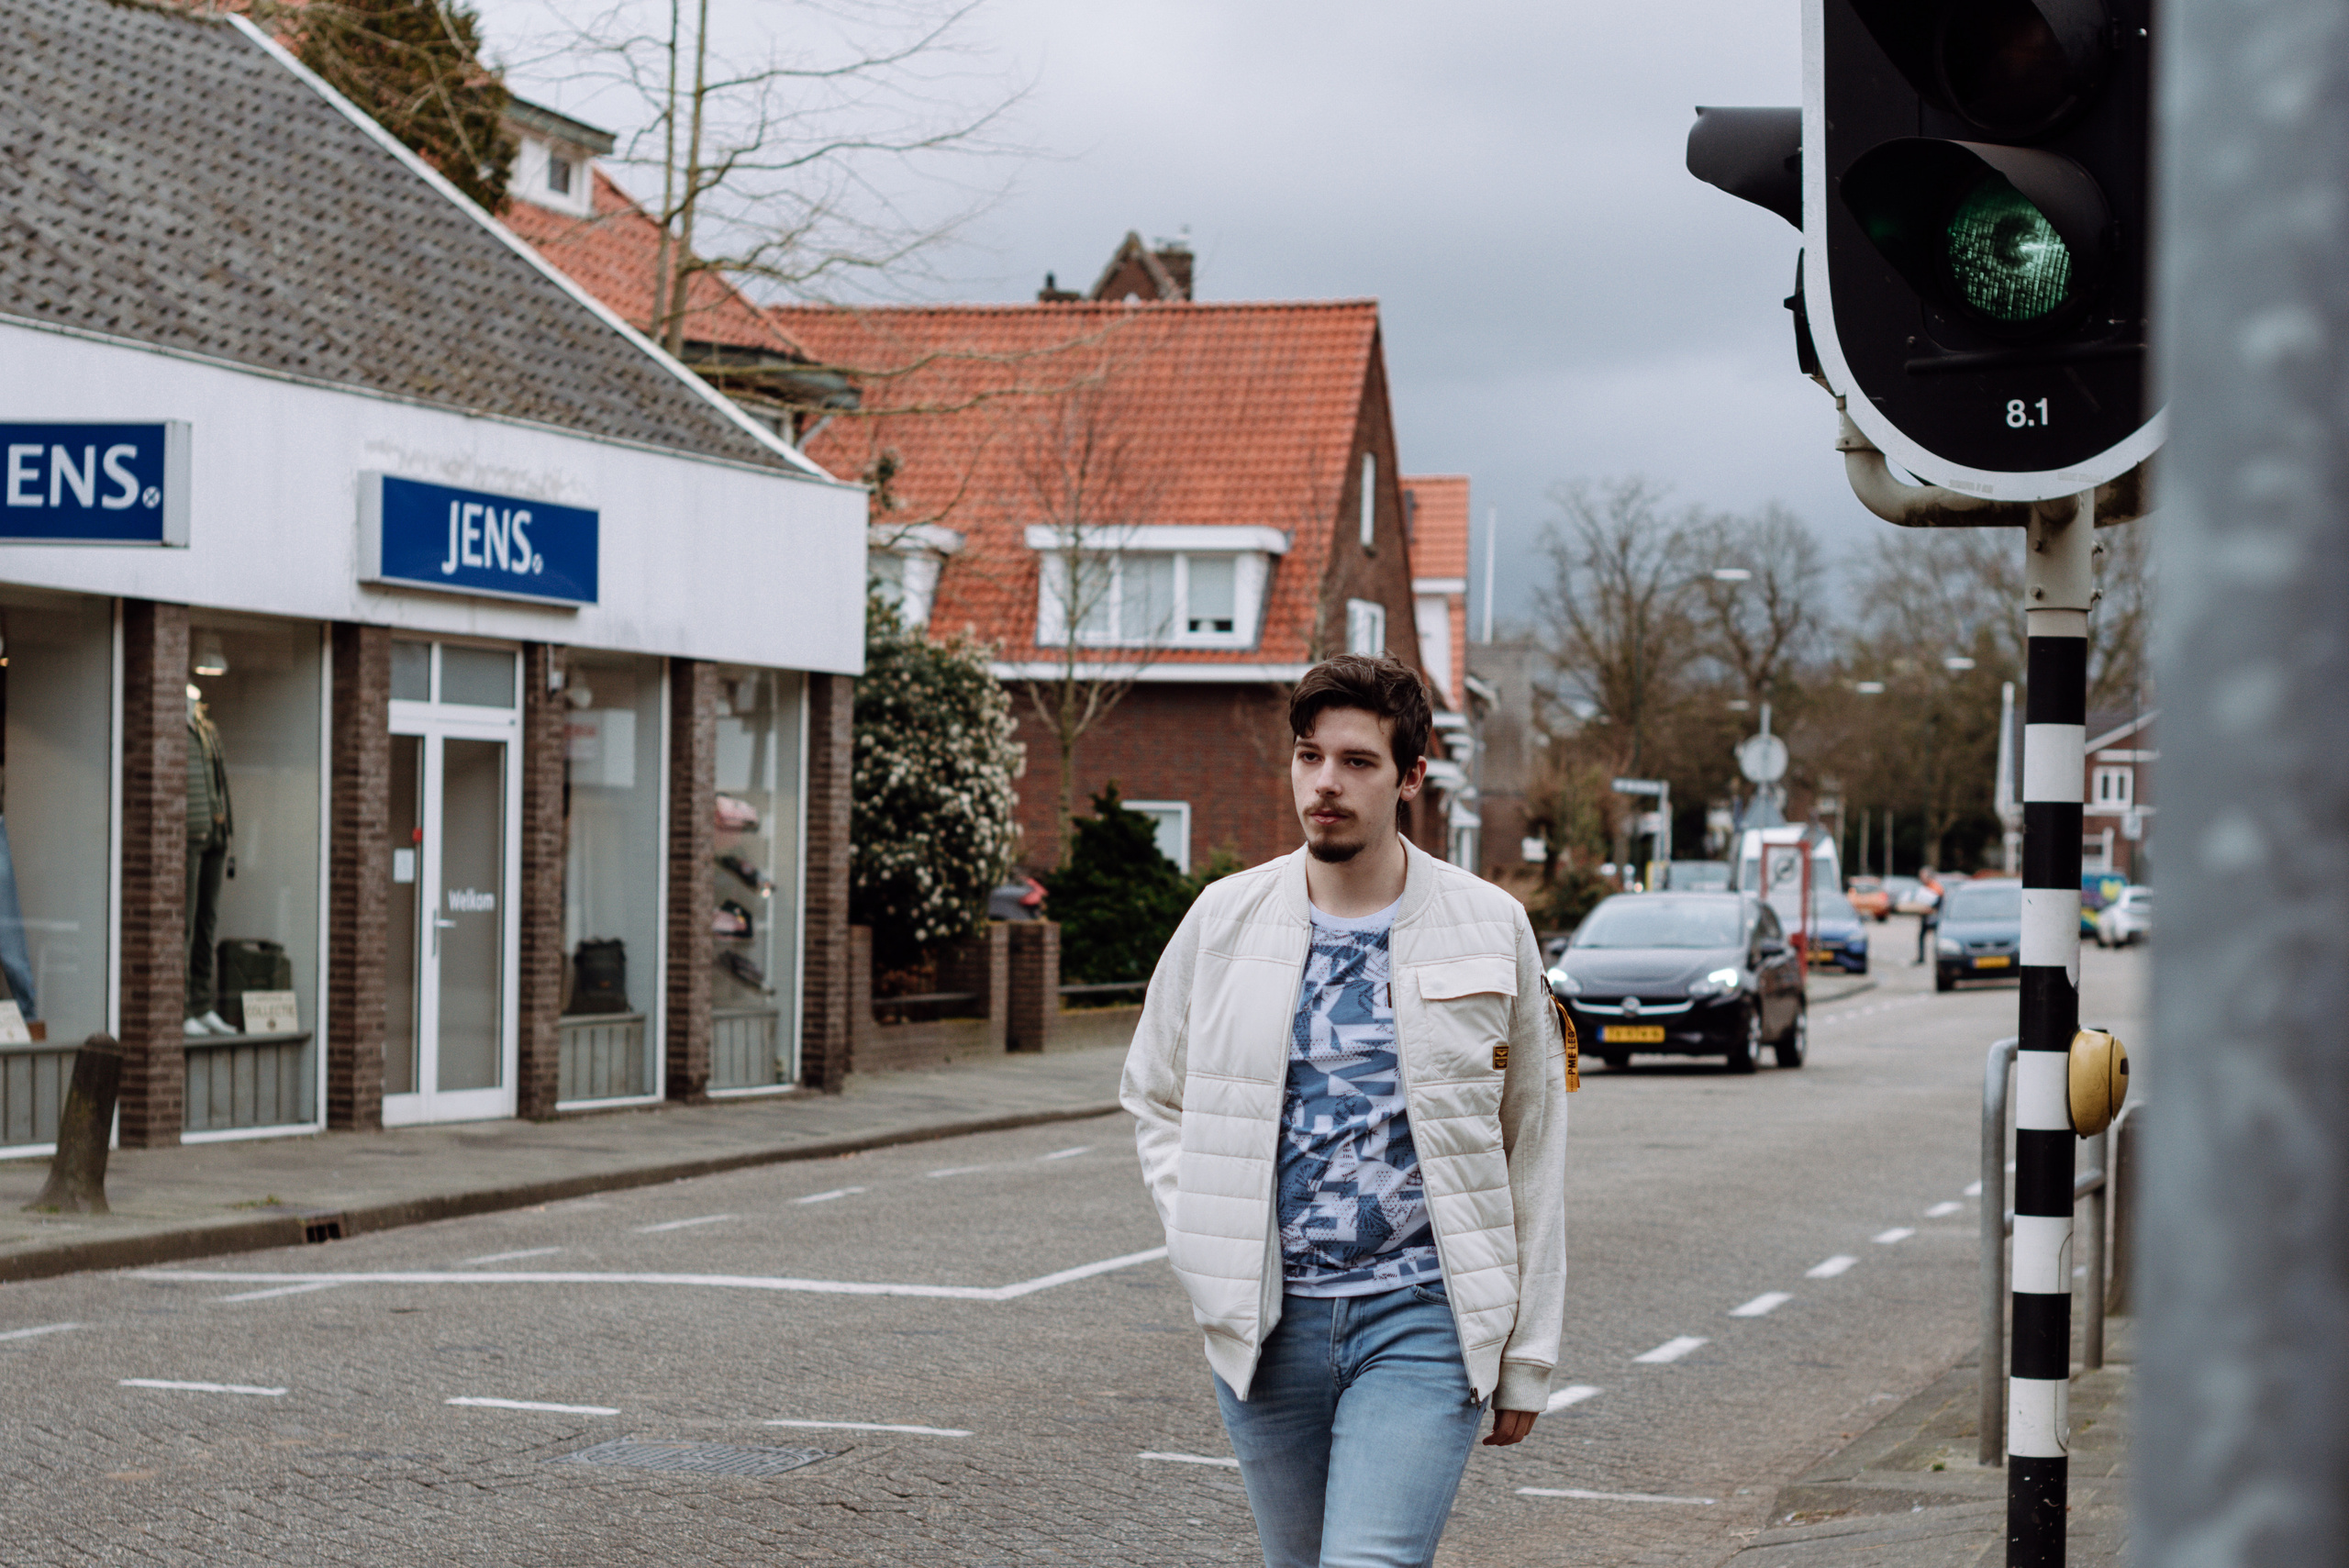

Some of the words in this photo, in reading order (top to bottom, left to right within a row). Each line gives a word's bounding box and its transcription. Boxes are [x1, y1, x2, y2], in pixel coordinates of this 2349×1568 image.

[2007, 397, 2048, 428] 8.1
[448, 887, 495, 911] Welkom
[1568, 1053, 1576, 1075] PME
